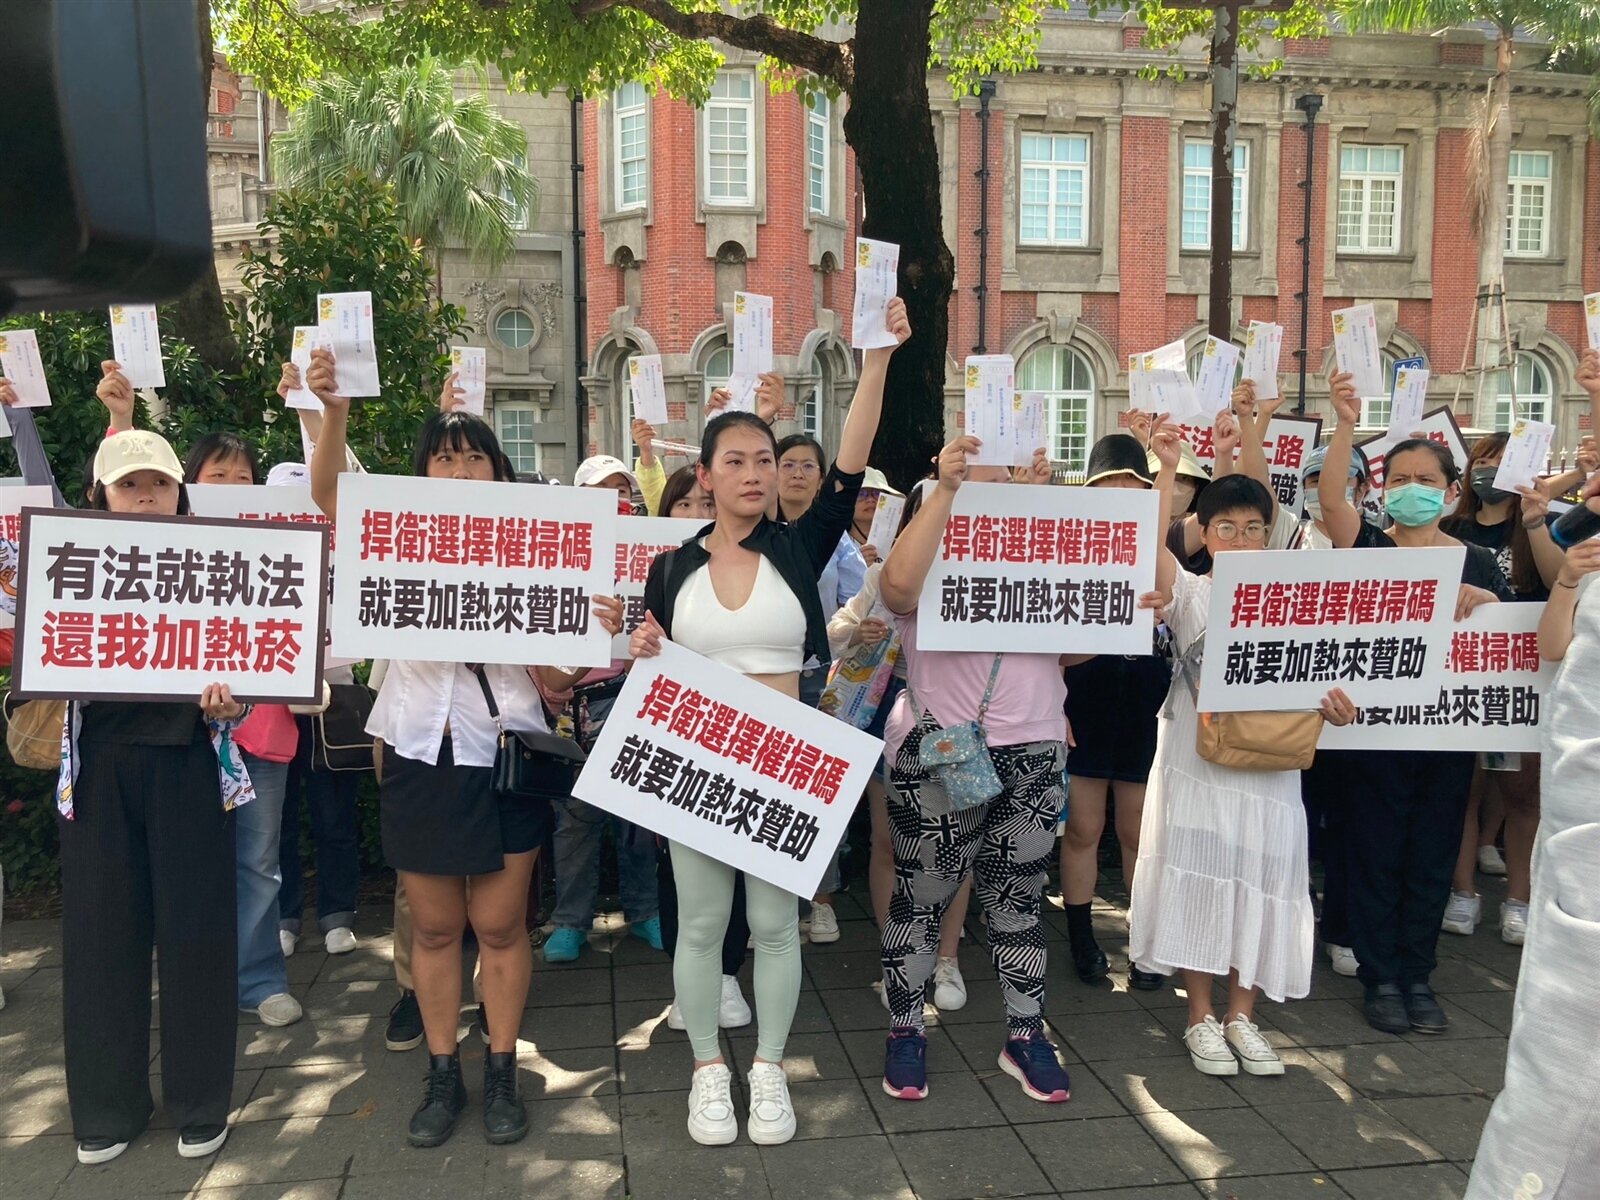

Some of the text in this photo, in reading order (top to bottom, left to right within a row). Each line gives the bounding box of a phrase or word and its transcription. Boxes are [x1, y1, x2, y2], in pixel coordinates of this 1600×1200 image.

[360, 510, 593, 572] 捍衛選擇權掃碼
[942, 515, 1137, 566] 捍衛選擇權掃碼
[46, 542, 304, 609] 有法就執法
[940, 575, 1134, 626] 就要加熱來贊助
[1230, 579, 1438, 628] 捍衛選擇權掃碼
[358, 576, 590, 636] 就要加熱來贊助
[41, 610, 303, 674] 還我加熱菸
[1223, 635, 1427, 686] 就要加熱來贊助
[1444, 632, 1540, 673] 權掃碼
[636, 674, 850, 805] 捍衛選擇權掃碼
[609, 733, 820, 863] 就要加熱來贊助
